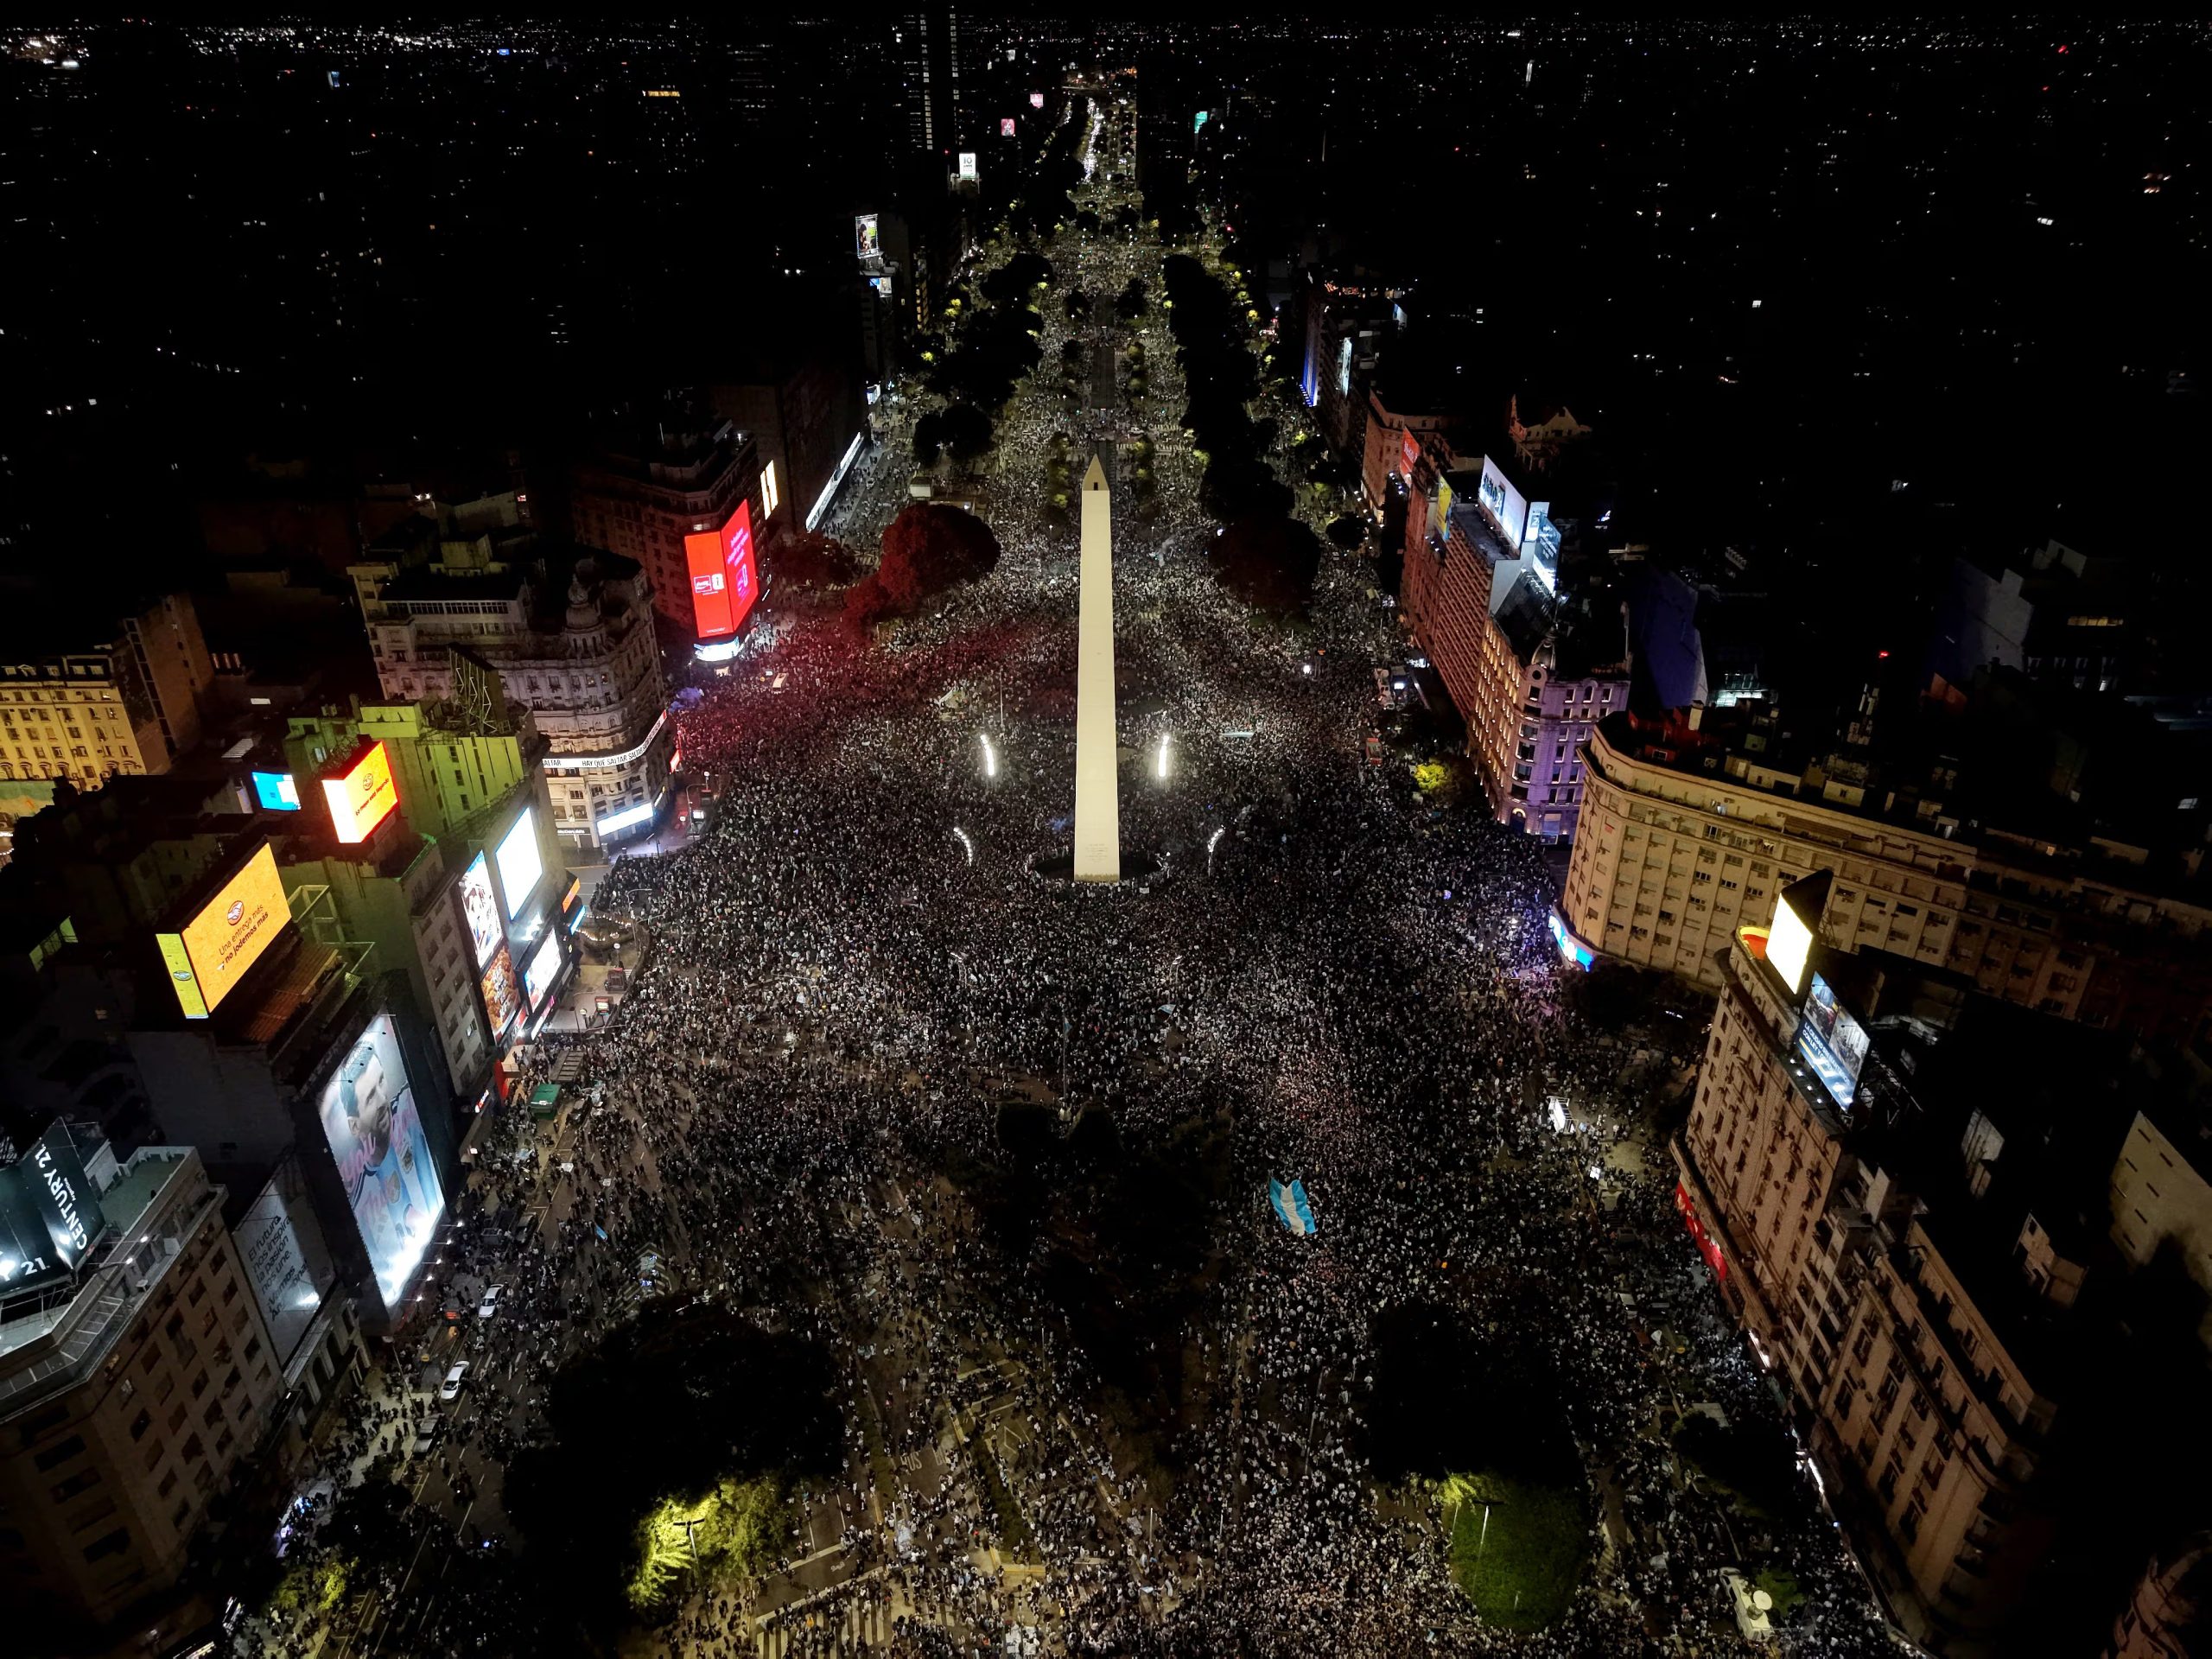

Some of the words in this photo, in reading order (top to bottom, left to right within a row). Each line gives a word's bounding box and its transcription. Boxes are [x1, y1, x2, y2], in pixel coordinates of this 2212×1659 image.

[607, 756, 627, 765] SALTAR
[219, 940, 232, 956] Una
[232, 918, 251, 942] entrega
[226, 952, 233, 963] no
[257, 912, 269, 927] más
[44, 1168, 88, 1250] CENTURY
[248, 1247, 257, 1262] El
[257, 1215, 281, 1250] futuro
[253, 1249, 268, 1273] nos
[268, 1215, 293, 1251] inspira
[257, 1270, 265, 1283] la
[262, 1272, 276, 1294] nos
[276, 1249, 293, 1274] une.
